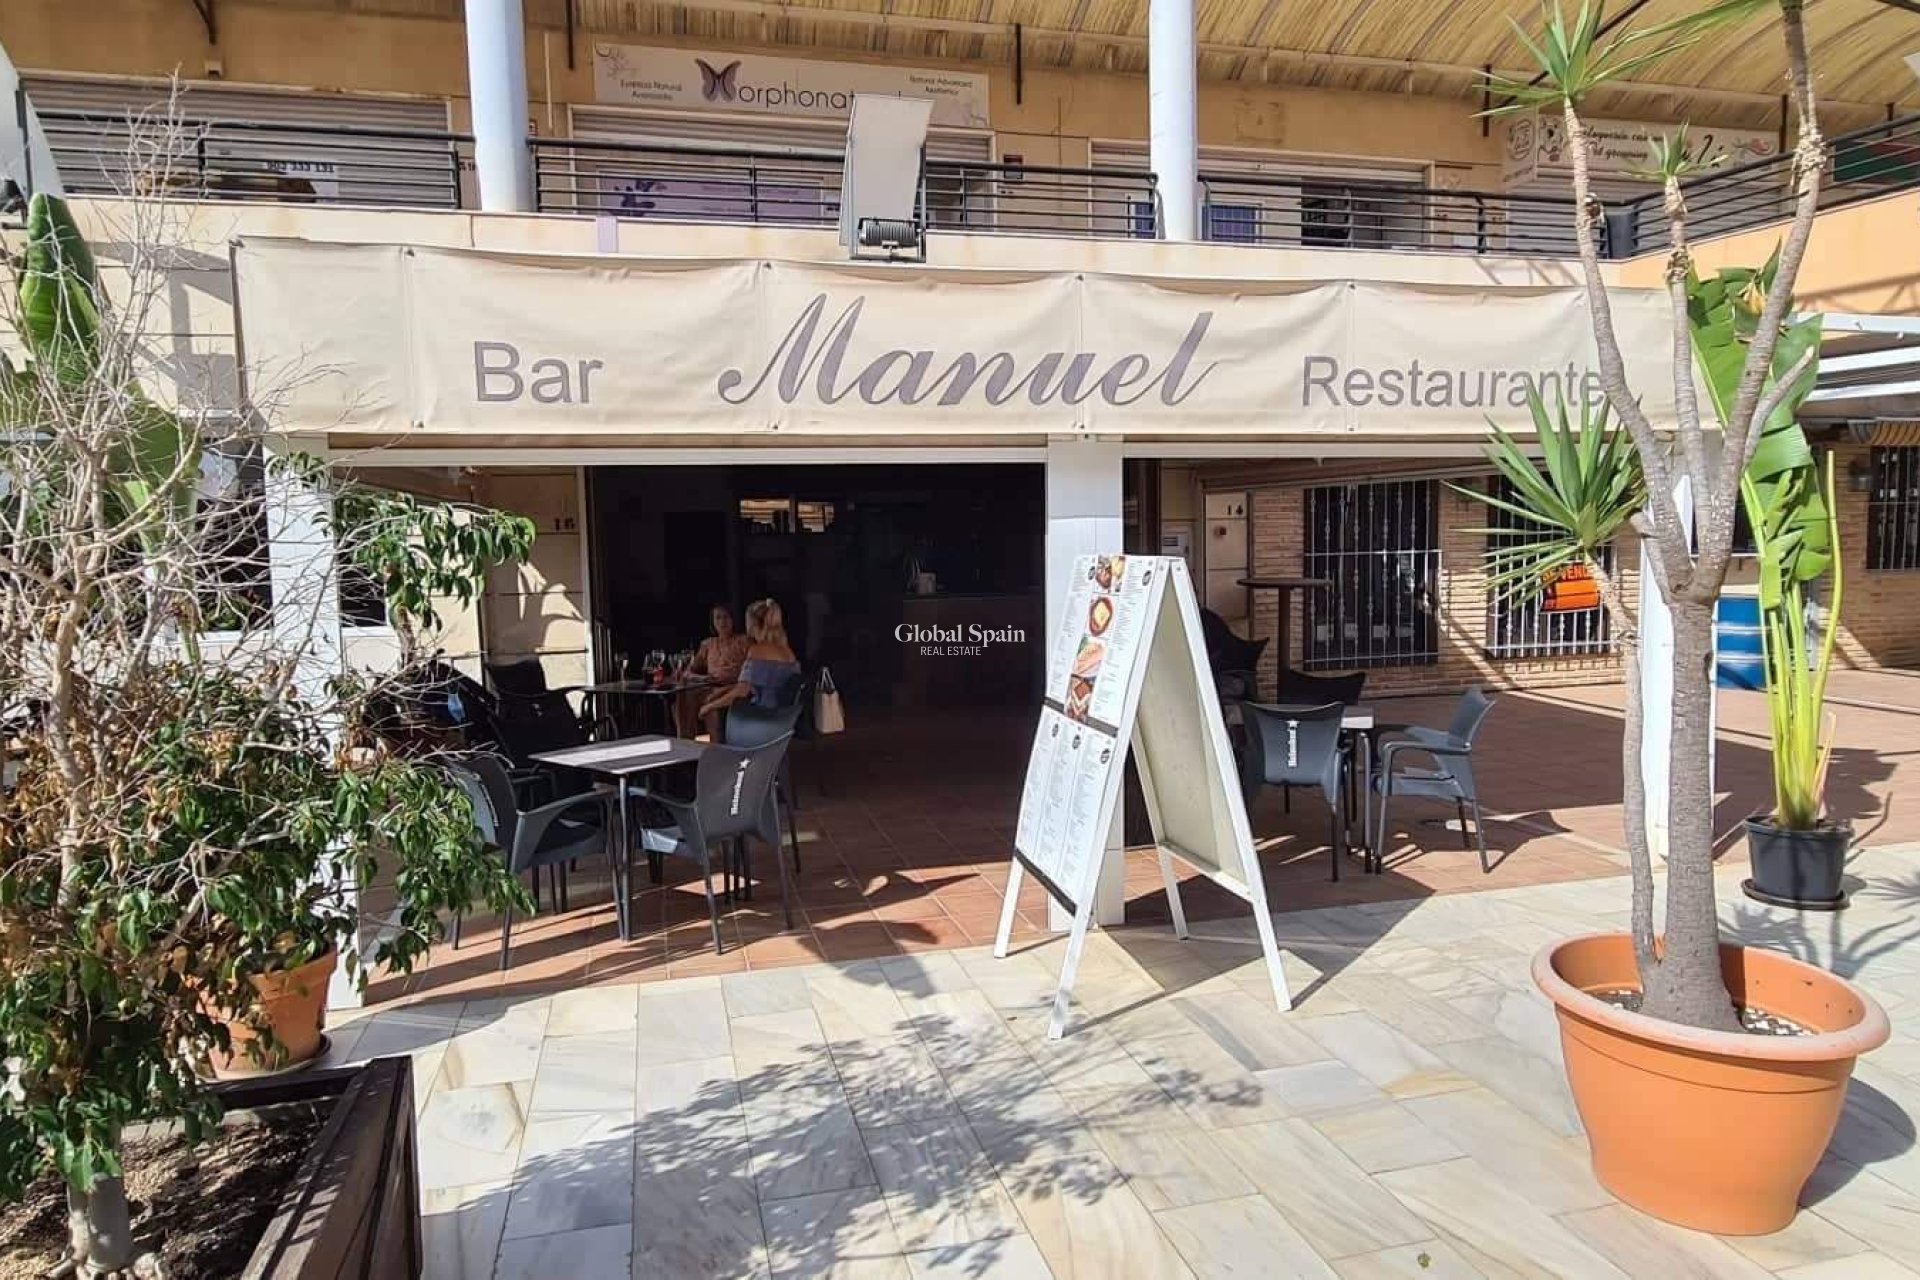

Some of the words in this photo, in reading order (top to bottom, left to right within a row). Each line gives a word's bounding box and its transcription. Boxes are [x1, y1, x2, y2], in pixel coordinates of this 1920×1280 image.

[474, 341, 605, 404] Bar
[718, 294, 1219, 407] Manuel
[1303, 356, 1604, 408] Restaurante
